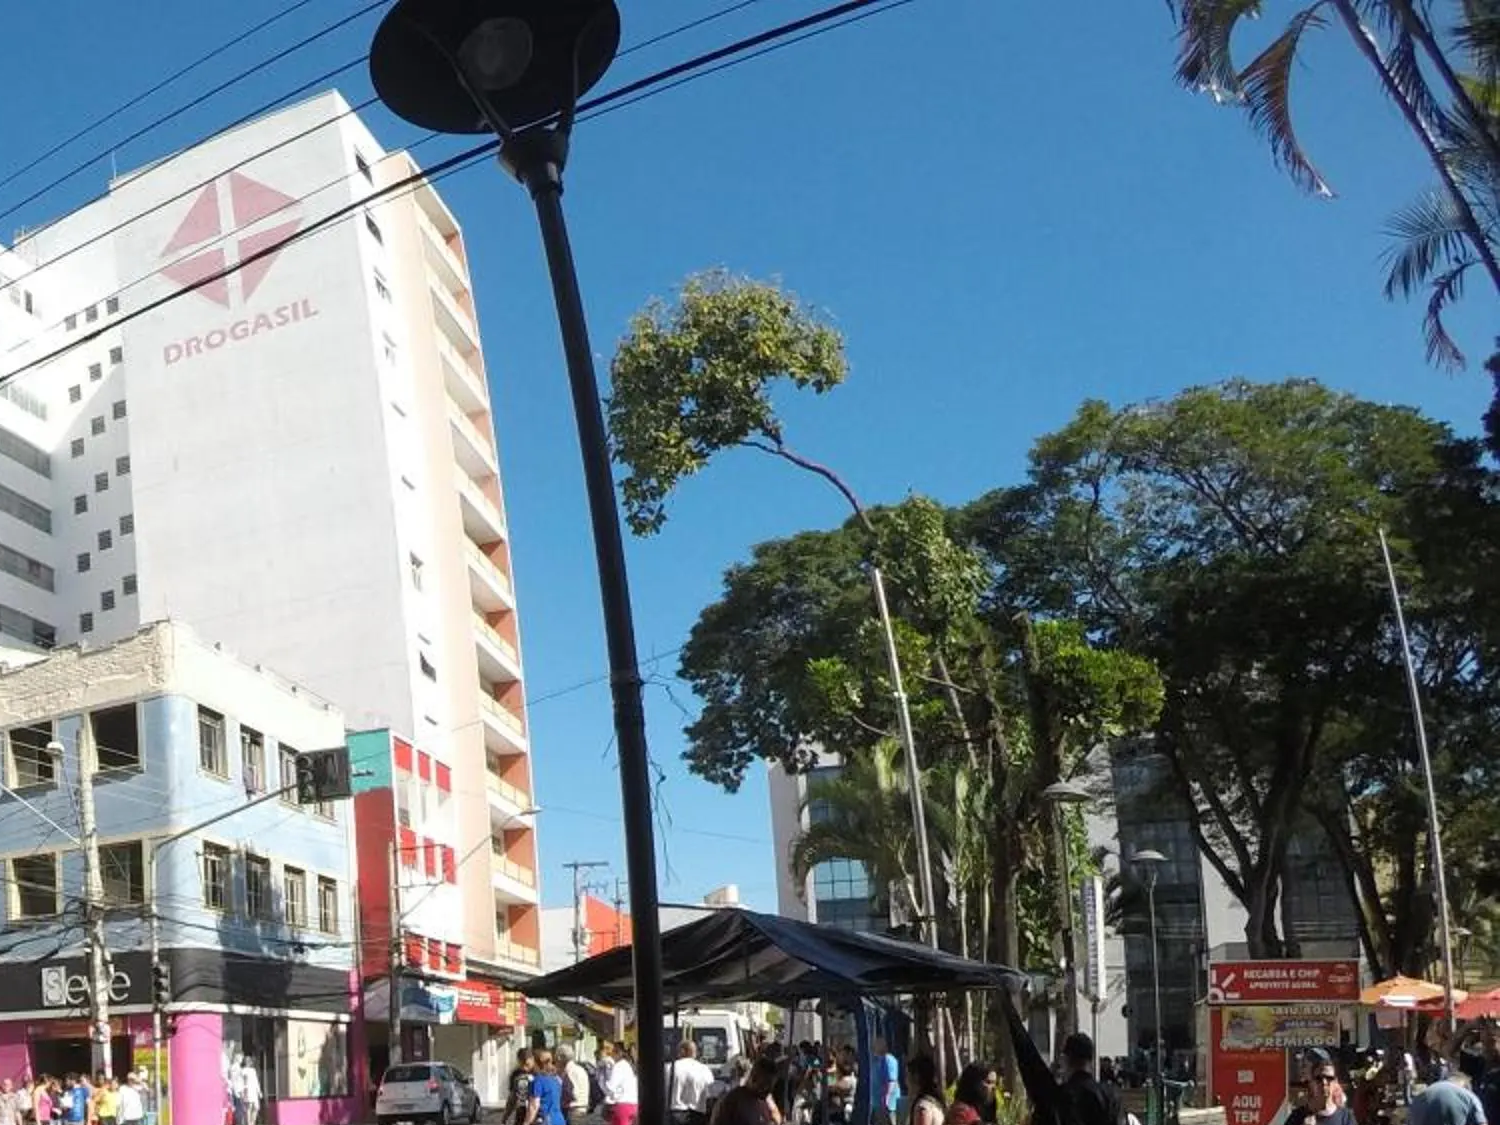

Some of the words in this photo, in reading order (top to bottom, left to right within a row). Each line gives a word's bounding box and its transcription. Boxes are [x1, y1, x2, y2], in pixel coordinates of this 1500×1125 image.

[163, 299, 319, 366] DROGASIL
[1232, 1095, 1262, 1108] AQUI
[1234, 1110, 1260, 1123] TEM
